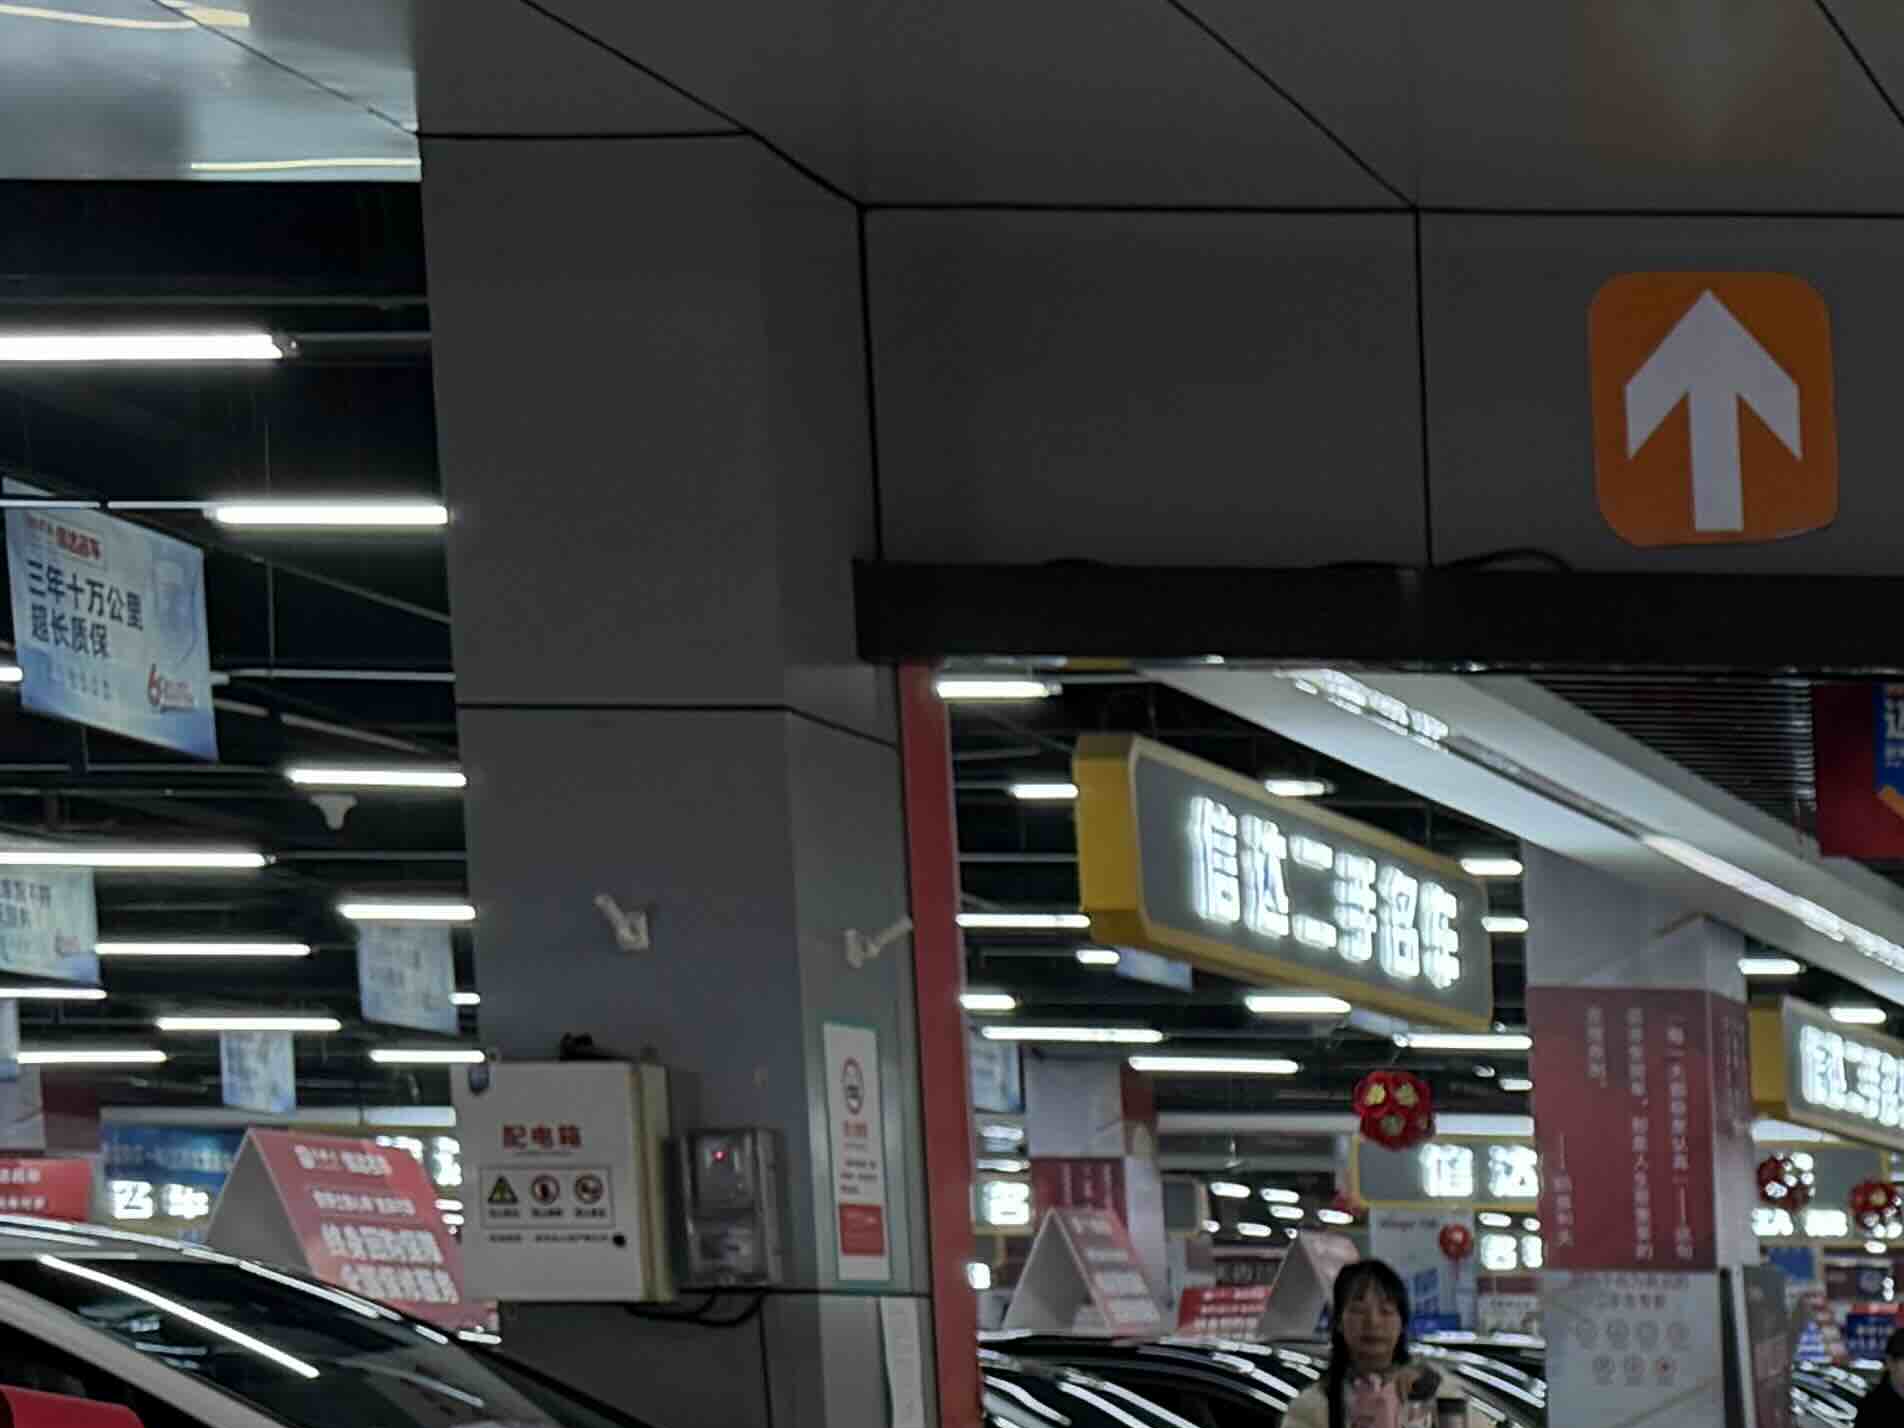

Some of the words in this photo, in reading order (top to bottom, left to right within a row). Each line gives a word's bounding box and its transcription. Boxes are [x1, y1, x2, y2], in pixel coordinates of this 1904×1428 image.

[27, 559, 144, 631] 三年十万公里
[31, 602, 109, 658] 超长质保
